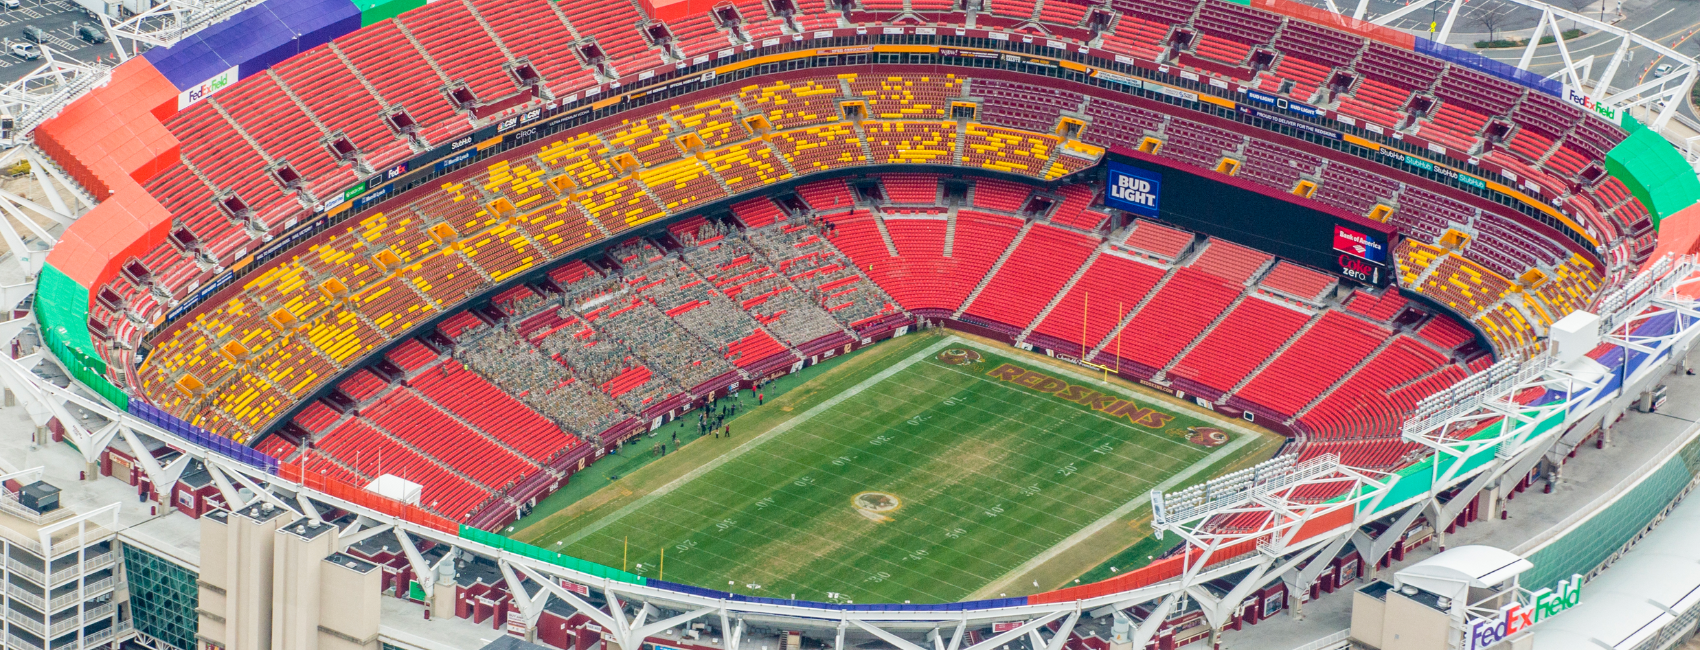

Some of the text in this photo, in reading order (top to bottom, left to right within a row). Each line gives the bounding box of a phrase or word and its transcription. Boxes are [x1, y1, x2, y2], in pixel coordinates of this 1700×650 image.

[189, 73, 228, 103] FedExField
[1260, 95, 1274, 103] LIGHT
[1569, 89, 1615, 120] FedExField
[1256, 111, 1272, 119] PROUD
[1278, 117, 1296, 127] DELIVER
[1301, 107, 1315, 115] LIGHT
[451, 137, 472, 150] StubHub
[388, 164, 406, 179] FedEx
[1380, 147, 1484, 188] StubHub StubHub StubHub StubHub
[1118, 174, 1151, 193] BUD
[1339, 230, 1354, 241] Bank
[1359, 237, 1382, 250] America
[1338, 253, 1372, 276] Coke
[1342, 267, 1366, 281] zero
[985, 363, 1176, 429] REDSKINS
[1469, 576, 1583, 650] FedExField
